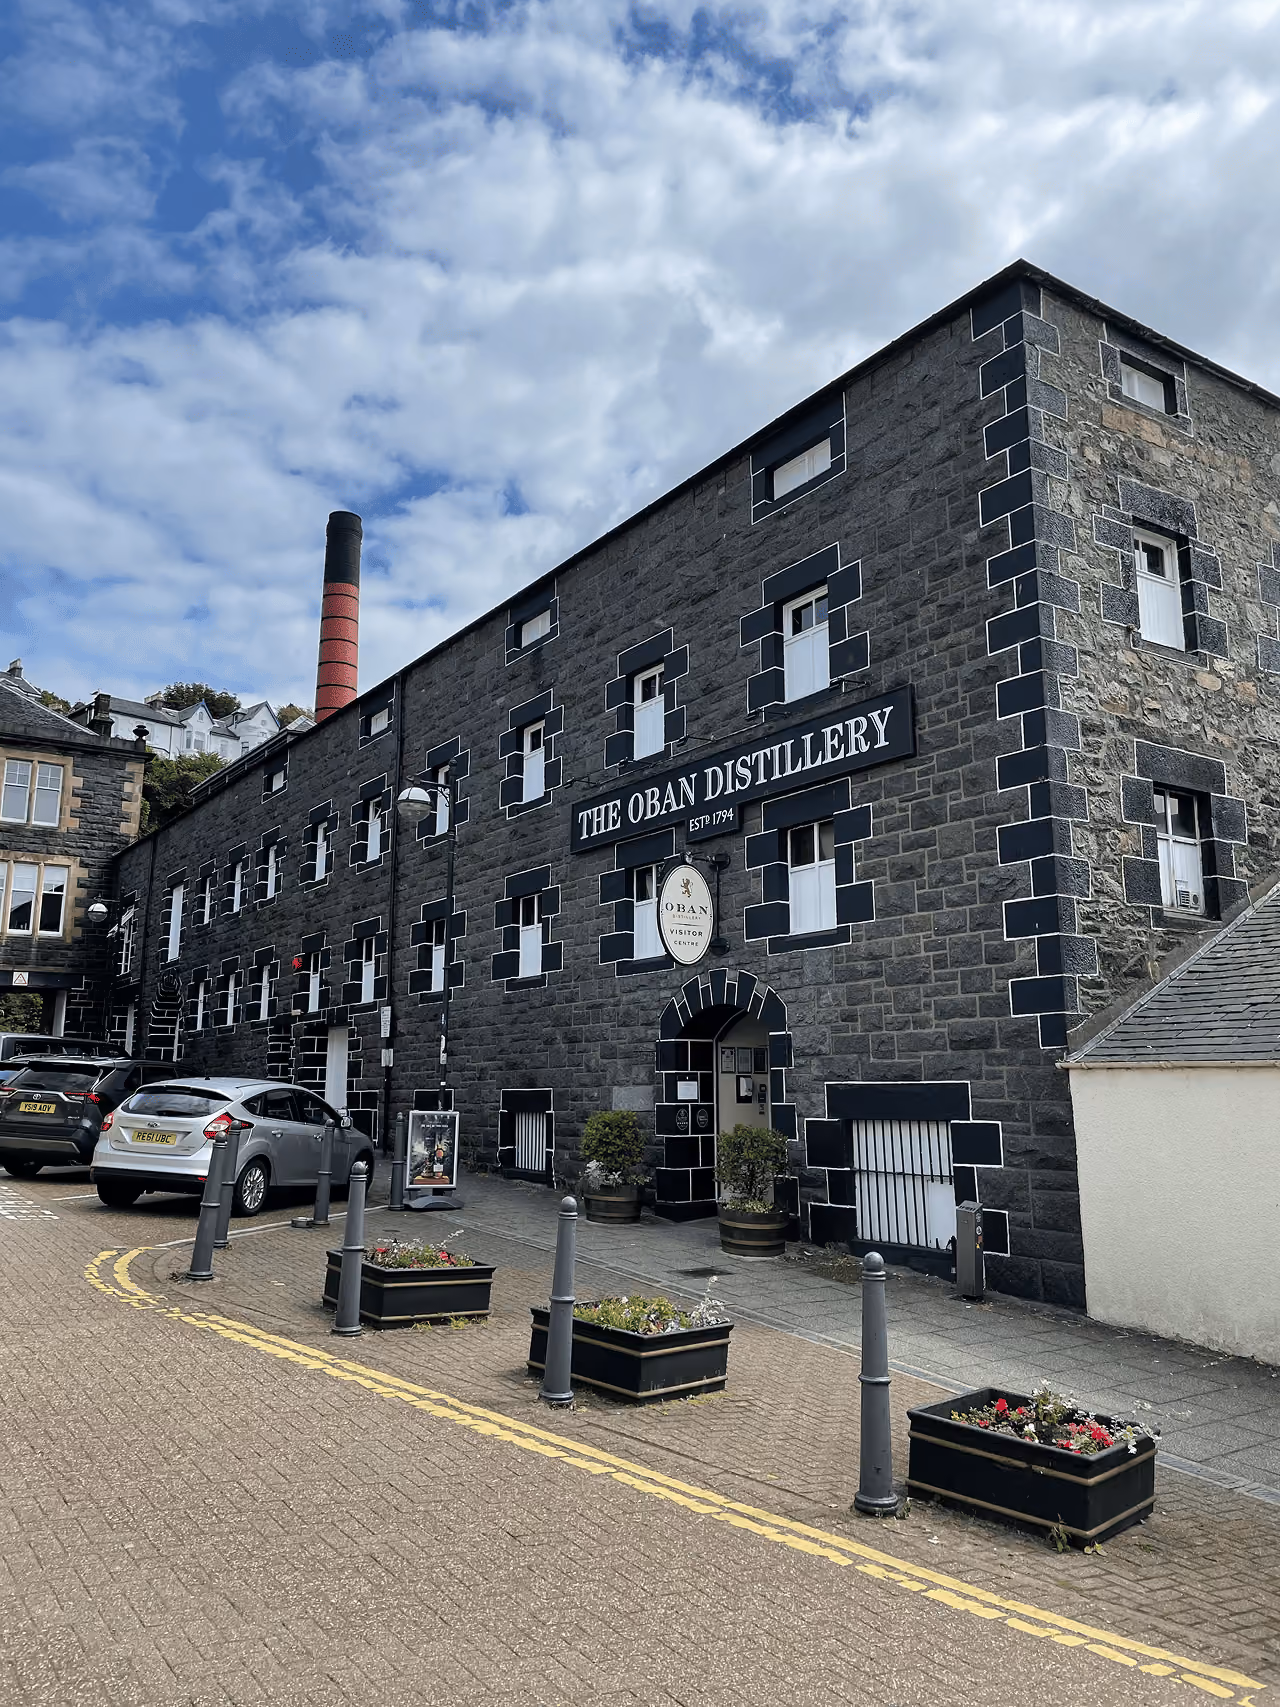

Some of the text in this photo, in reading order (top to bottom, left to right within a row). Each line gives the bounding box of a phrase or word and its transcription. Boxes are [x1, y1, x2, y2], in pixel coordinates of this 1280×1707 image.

[578, 706, 894, 840] THE OBAN DISTILLERY
[713, 807, 734, 825] 1794
[665, 902, 708, 915] OBAN
[670, 929, 703, 937] VISITOR
